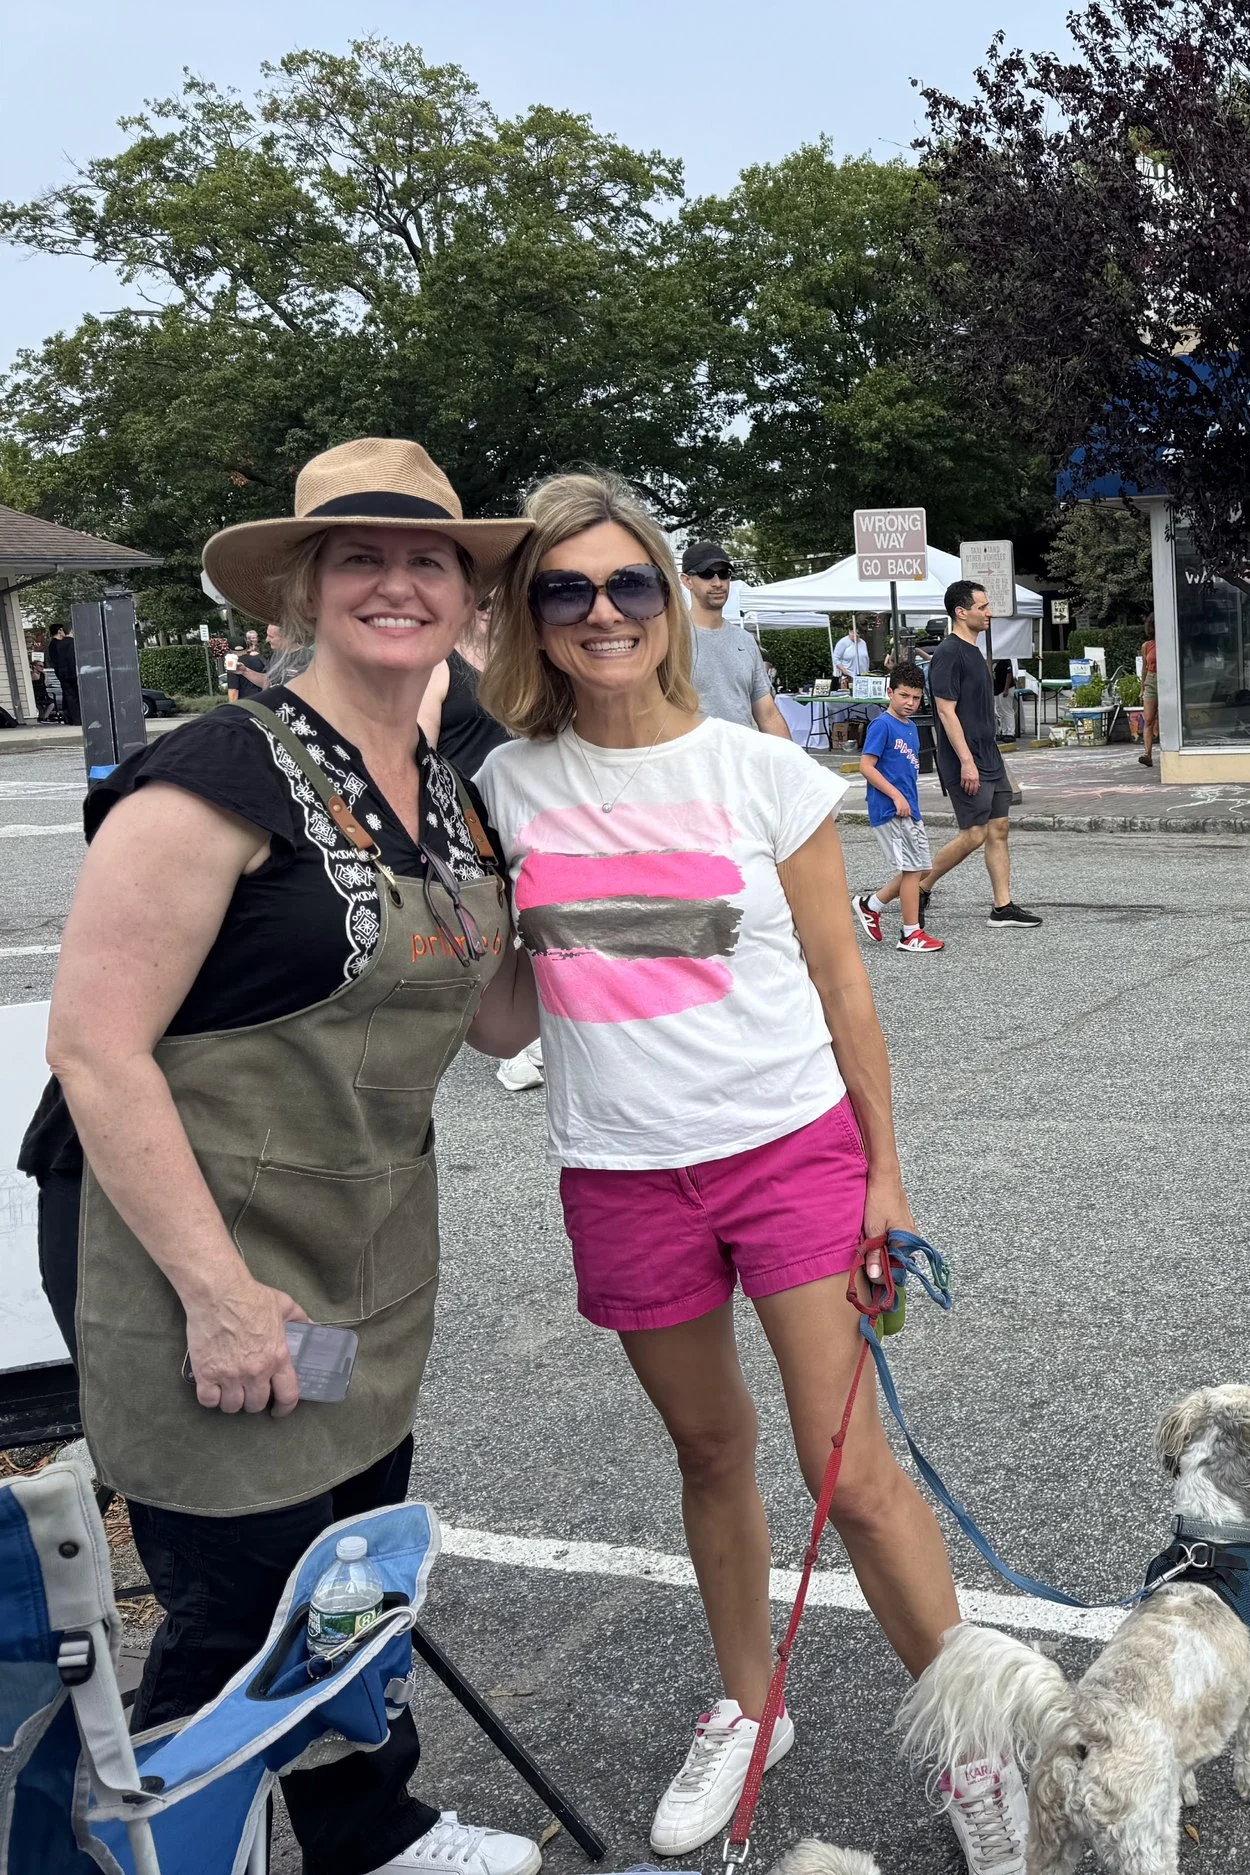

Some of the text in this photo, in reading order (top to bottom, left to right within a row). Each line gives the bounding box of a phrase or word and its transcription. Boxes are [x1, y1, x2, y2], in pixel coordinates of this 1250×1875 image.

[859, 514, 922, 533] WRONG
[874, 532, 907, 549] WAY
[862, 558, 923, 575] GO BACK
